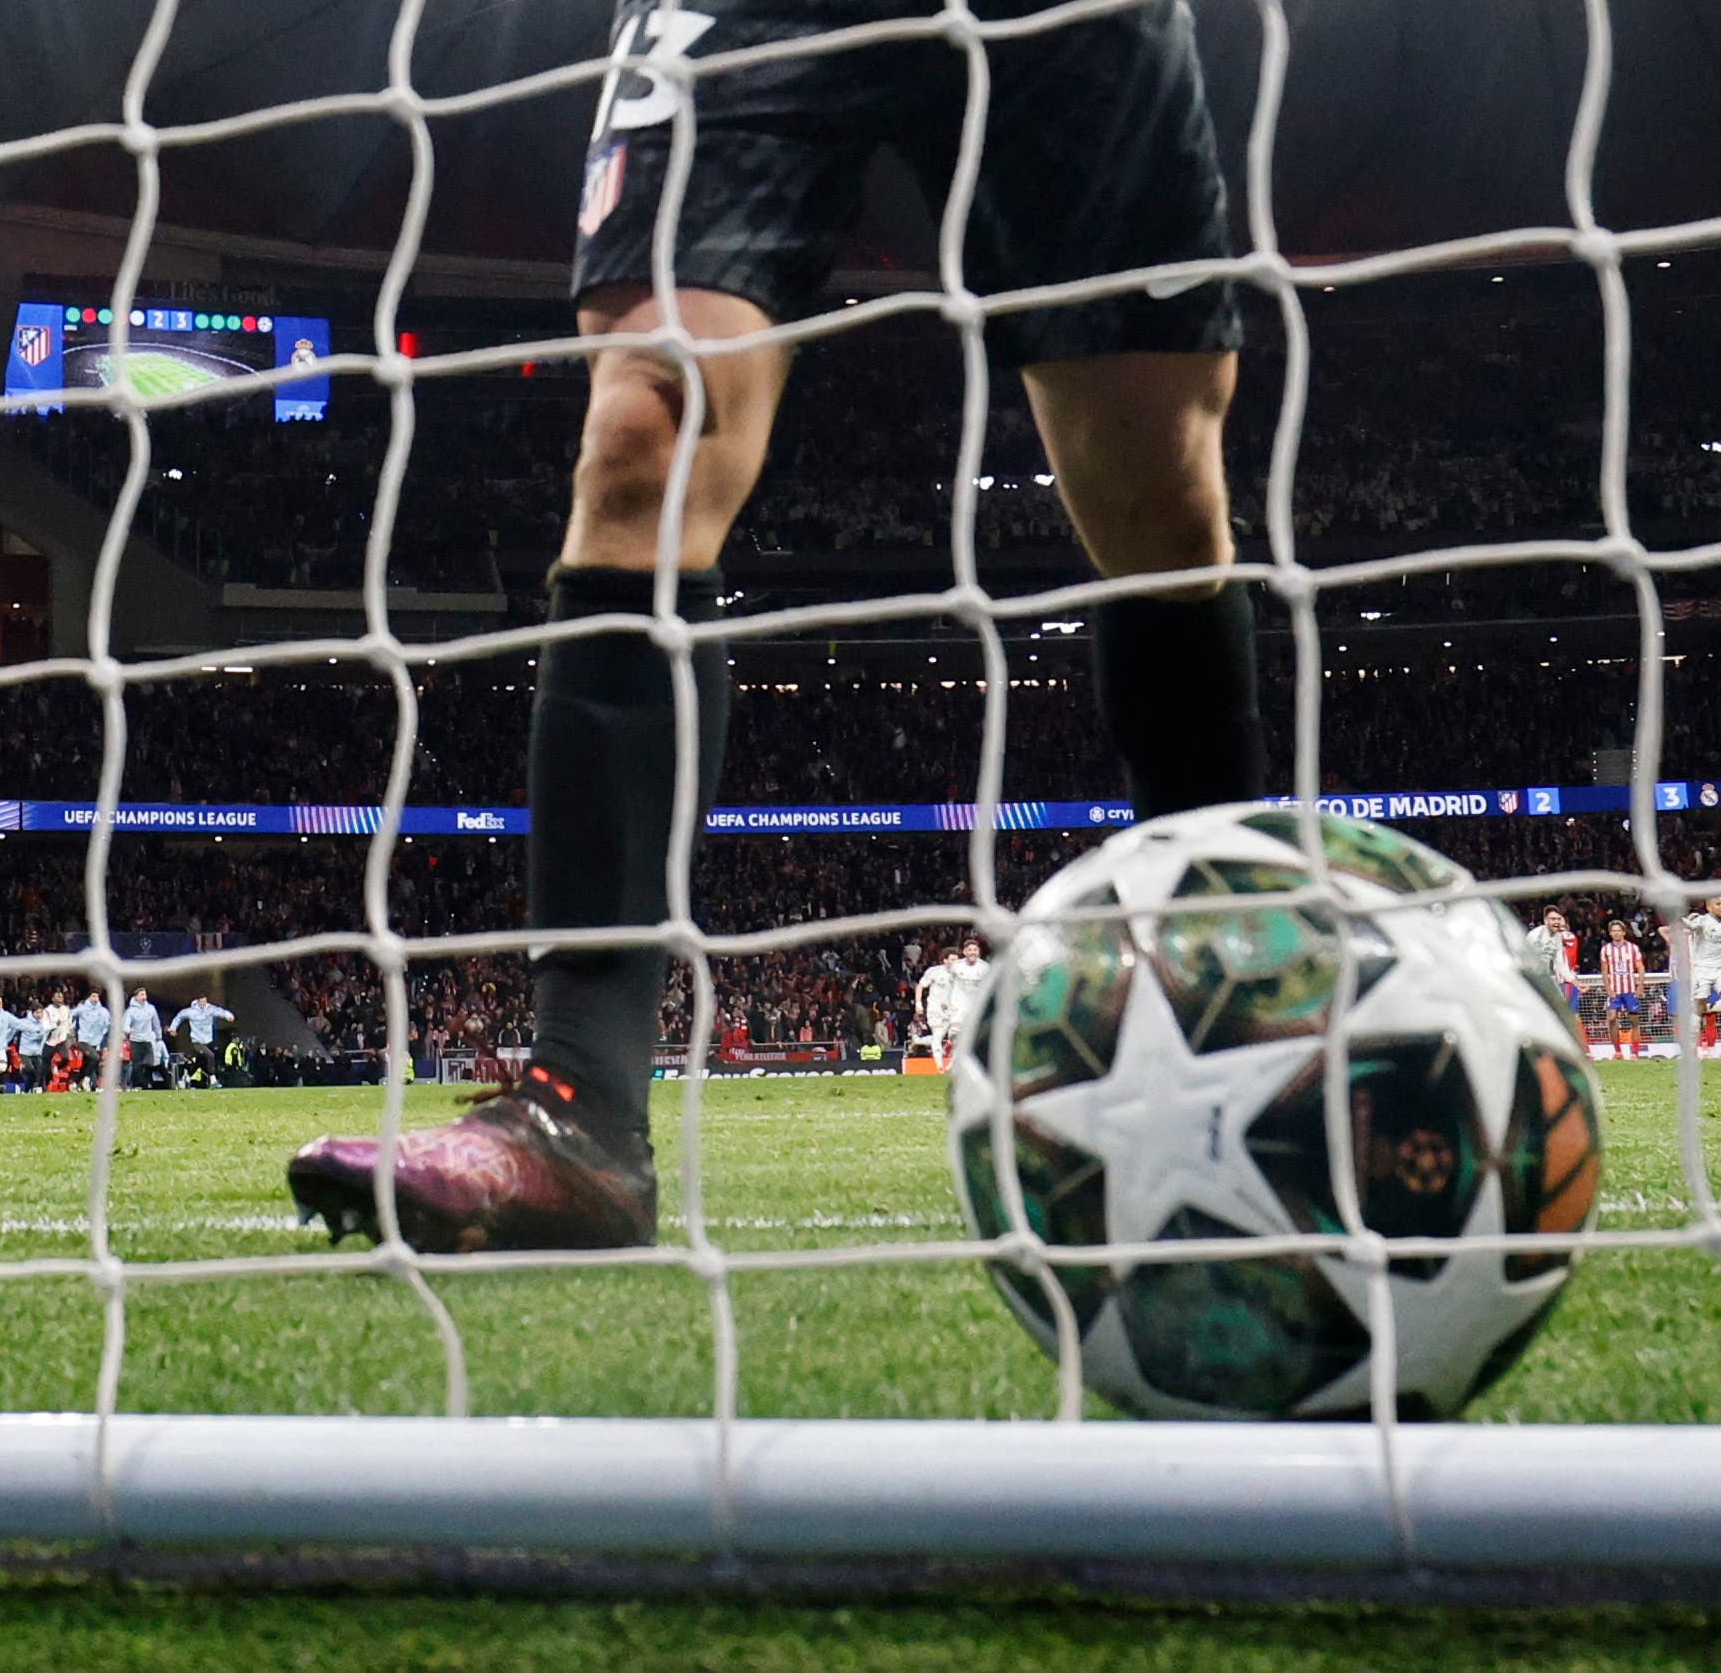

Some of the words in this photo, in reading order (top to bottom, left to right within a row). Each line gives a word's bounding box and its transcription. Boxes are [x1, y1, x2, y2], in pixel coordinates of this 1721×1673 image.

[153, 310, 164, 328] 2
[176, 311, 187, 329] 3
[1352, 798, 1385, 819] DE
[1389, 793, 1488, 817] MADRID
[1535, 792, 1552, 812] 2
[1662, 786, 1681, 808] 3
[64, 810, 102, 824] UEFA
[198, 812, 257, 826] LEAGUE
[457, 812, 505, 830] FedEx
[706, 813, 745, 826] UEFA
[748, 812, 839, 826] CHAMPIONS
[842, 811, 902, 825] LEAGUE
